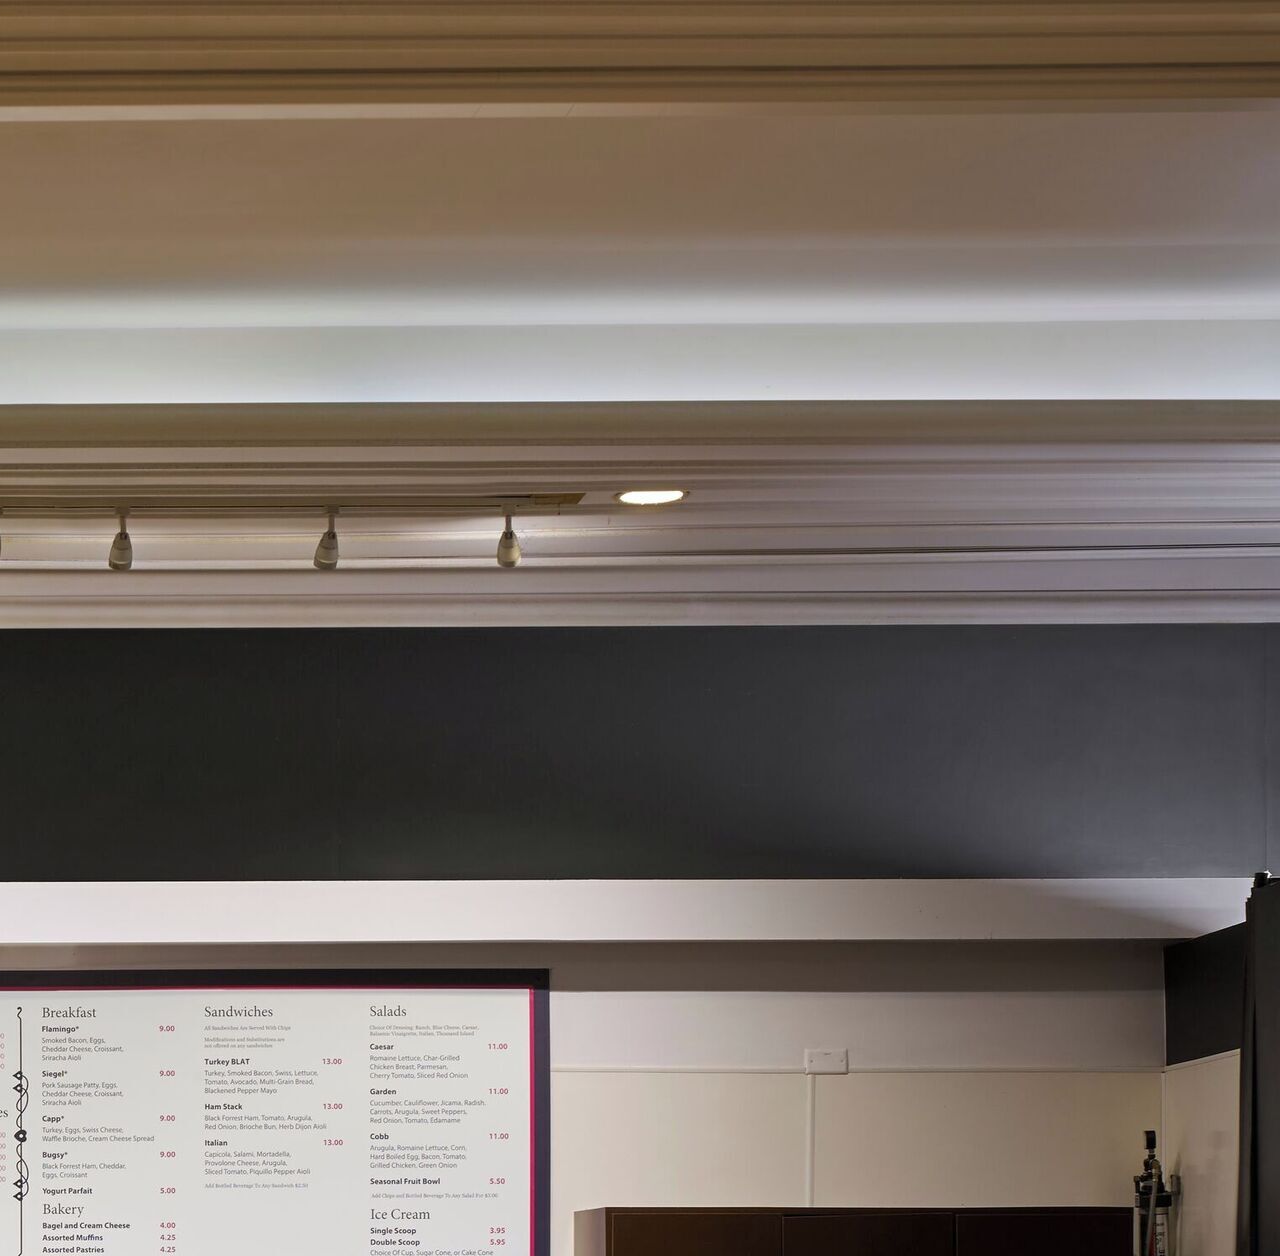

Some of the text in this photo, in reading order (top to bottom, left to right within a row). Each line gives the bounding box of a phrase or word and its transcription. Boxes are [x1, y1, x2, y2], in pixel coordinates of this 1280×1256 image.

[42, 1006, 96, 1018] Breakfast
[204, 1005, 273, 1017] Sandwiches
[370, 1005, 407, 1017] Salads
[204, 1058, 230, 1067] Turkey
[42, 1188, 67, 1196] Yogurt
[43, 1203, 84, 1218] Bakery
[371, 1209, 430, 1220] Ice Cream
[42, 1222, 63, 1231] Bagel
[370, 1227, 393, 1236] Single
[394, 1227, 417, 1235] Scoop
[398, 1239, 420, 1247] Scoop
[490, 1238, 506, 1246] 5.95
